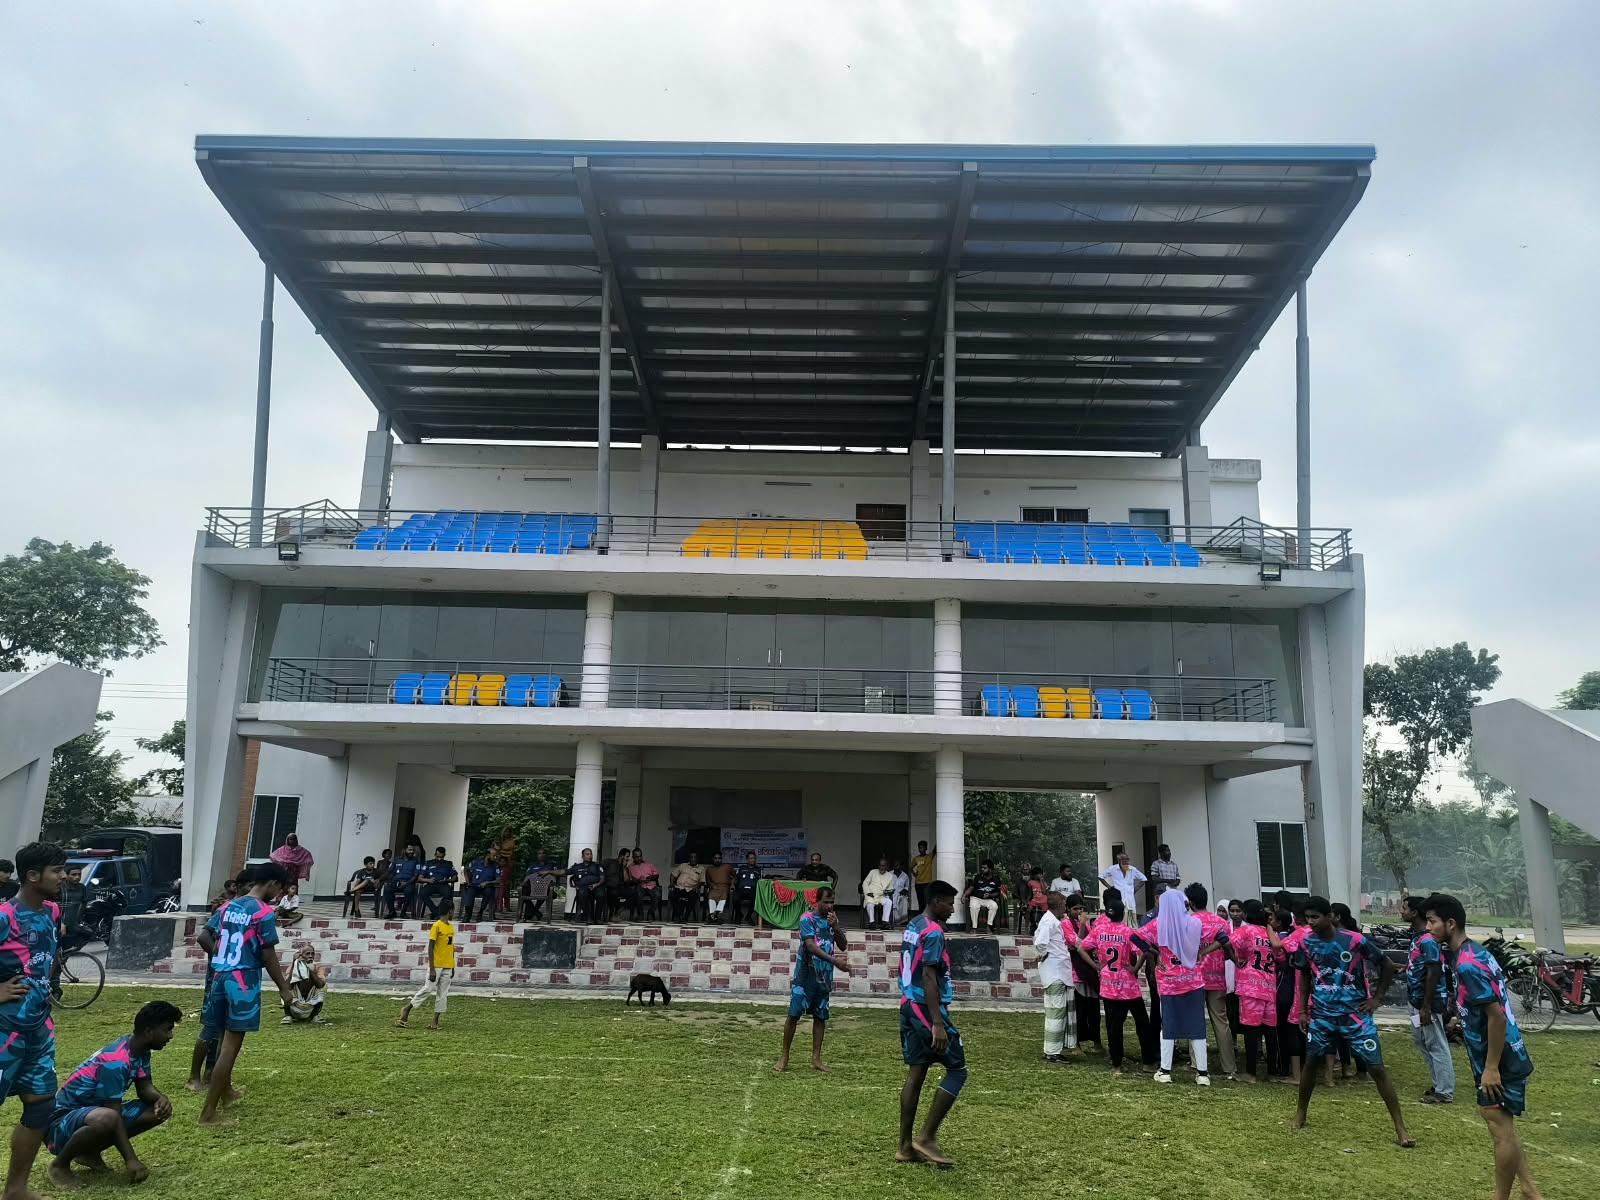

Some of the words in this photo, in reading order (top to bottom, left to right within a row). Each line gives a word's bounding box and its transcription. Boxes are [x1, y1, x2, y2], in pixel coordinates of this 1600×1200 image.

[223, 911, 252, 926] RABBI
[211, 929, 244, 967] 13
[1105, 947, 1119, 972] 2
[1251, 950, 1275, 974] 12
